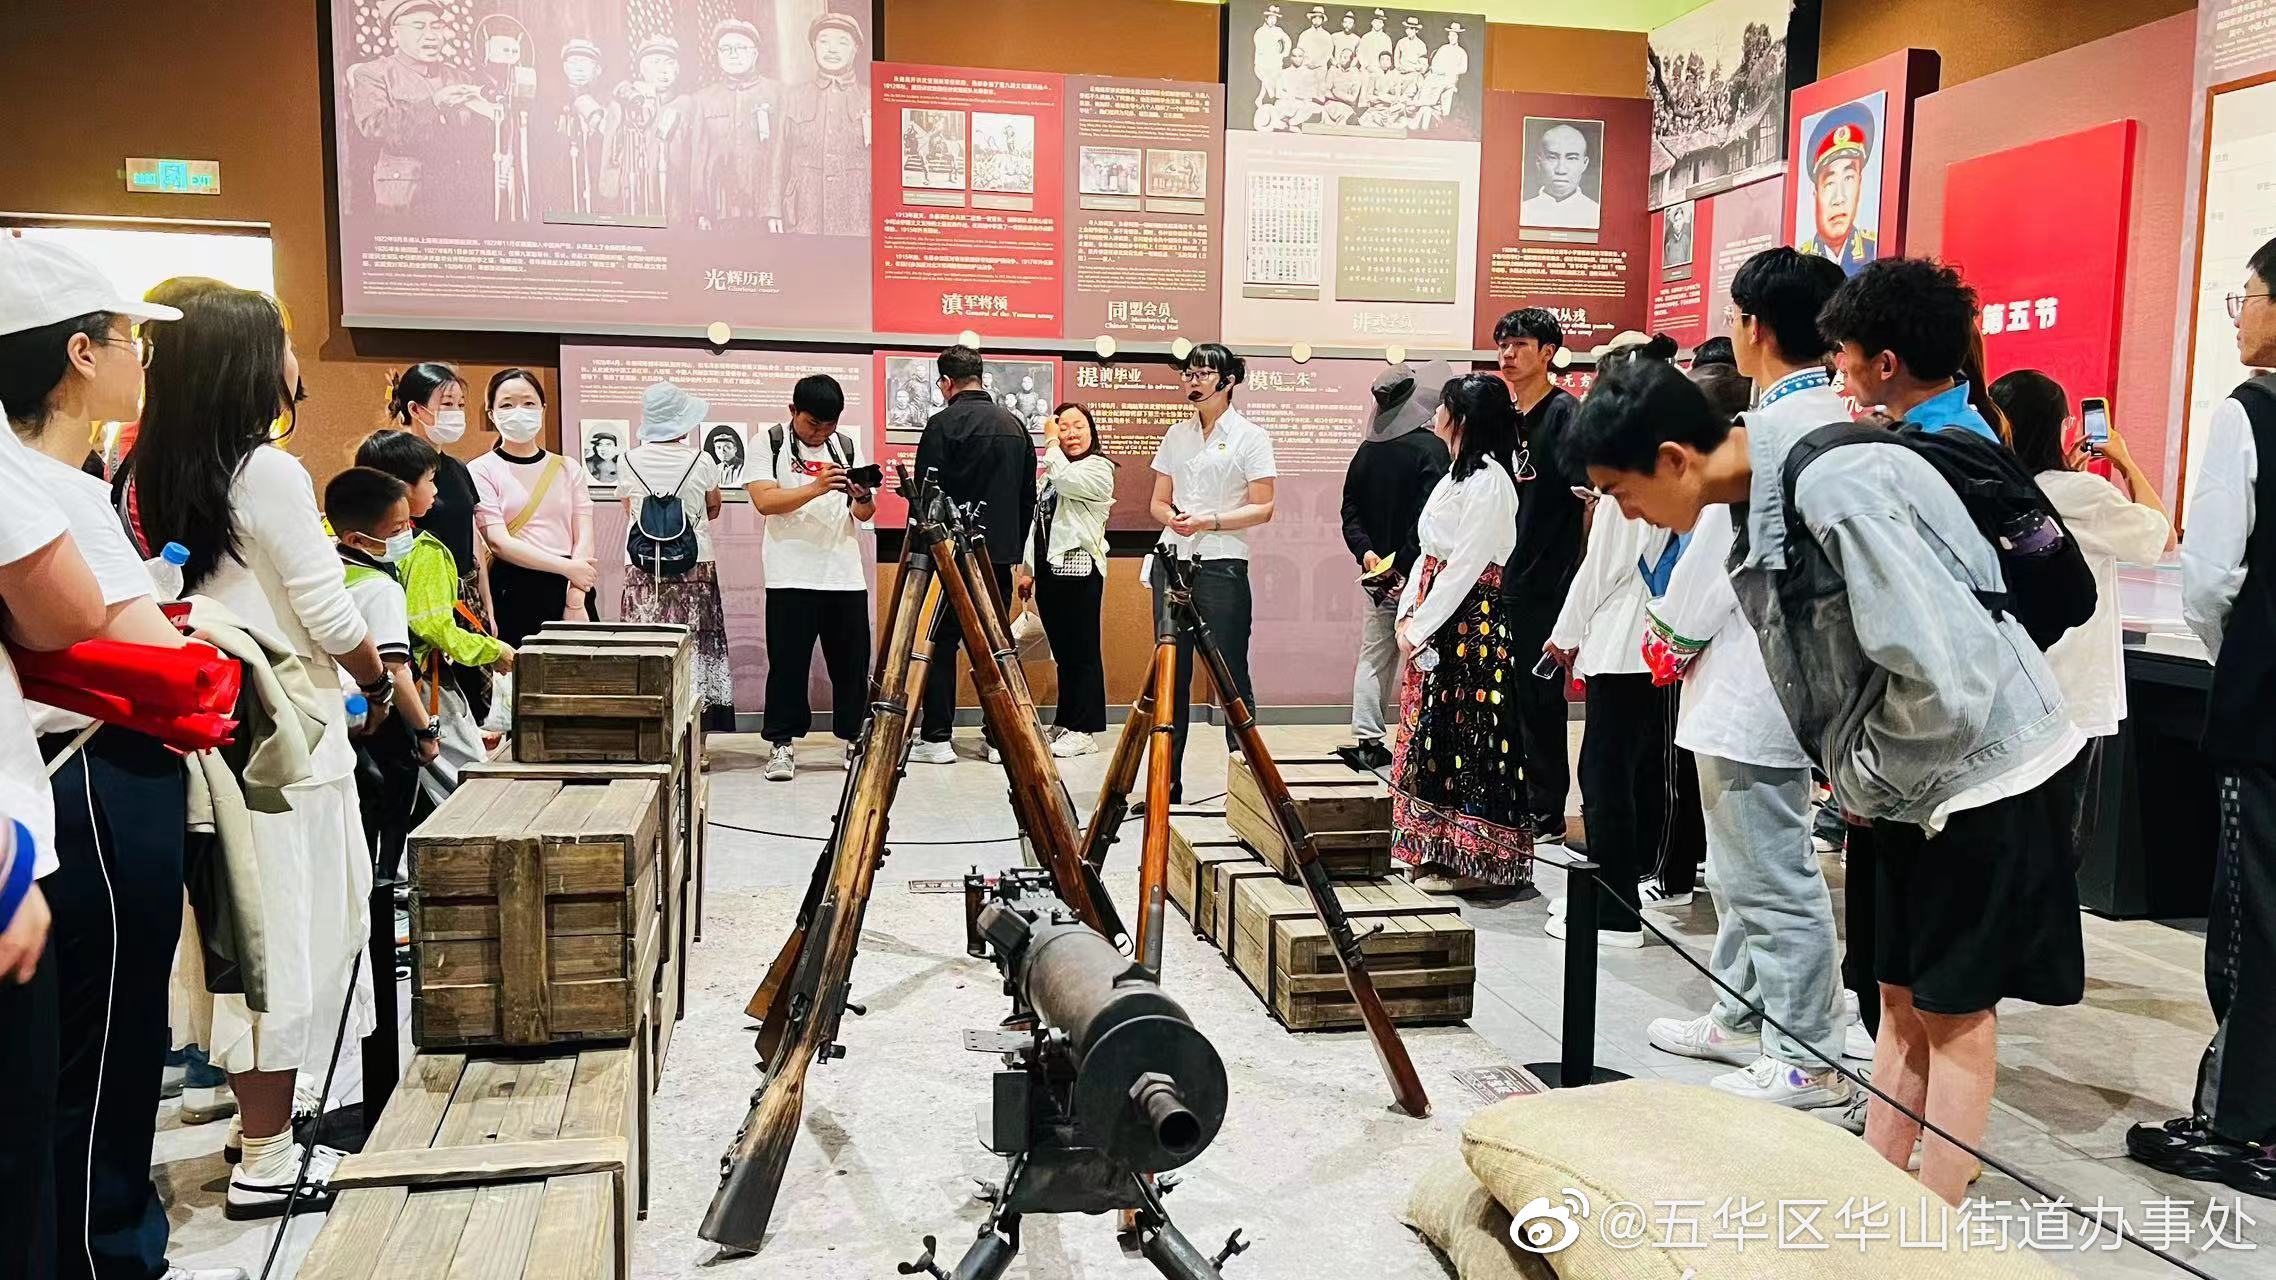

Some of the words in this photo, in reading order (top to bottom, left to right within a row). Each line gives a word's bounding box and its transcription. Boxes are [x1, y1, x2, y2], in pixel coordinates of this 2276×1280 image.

[703, 268, 775, 291] 光辉历程
[941, 292, 1008, 316] 滇军将领
[1108, 300, 1171, 322] 同盟会员
[1981, 296, 2059, 336] 第五节
[1077, 366, 1142, 388] 提前毕业
